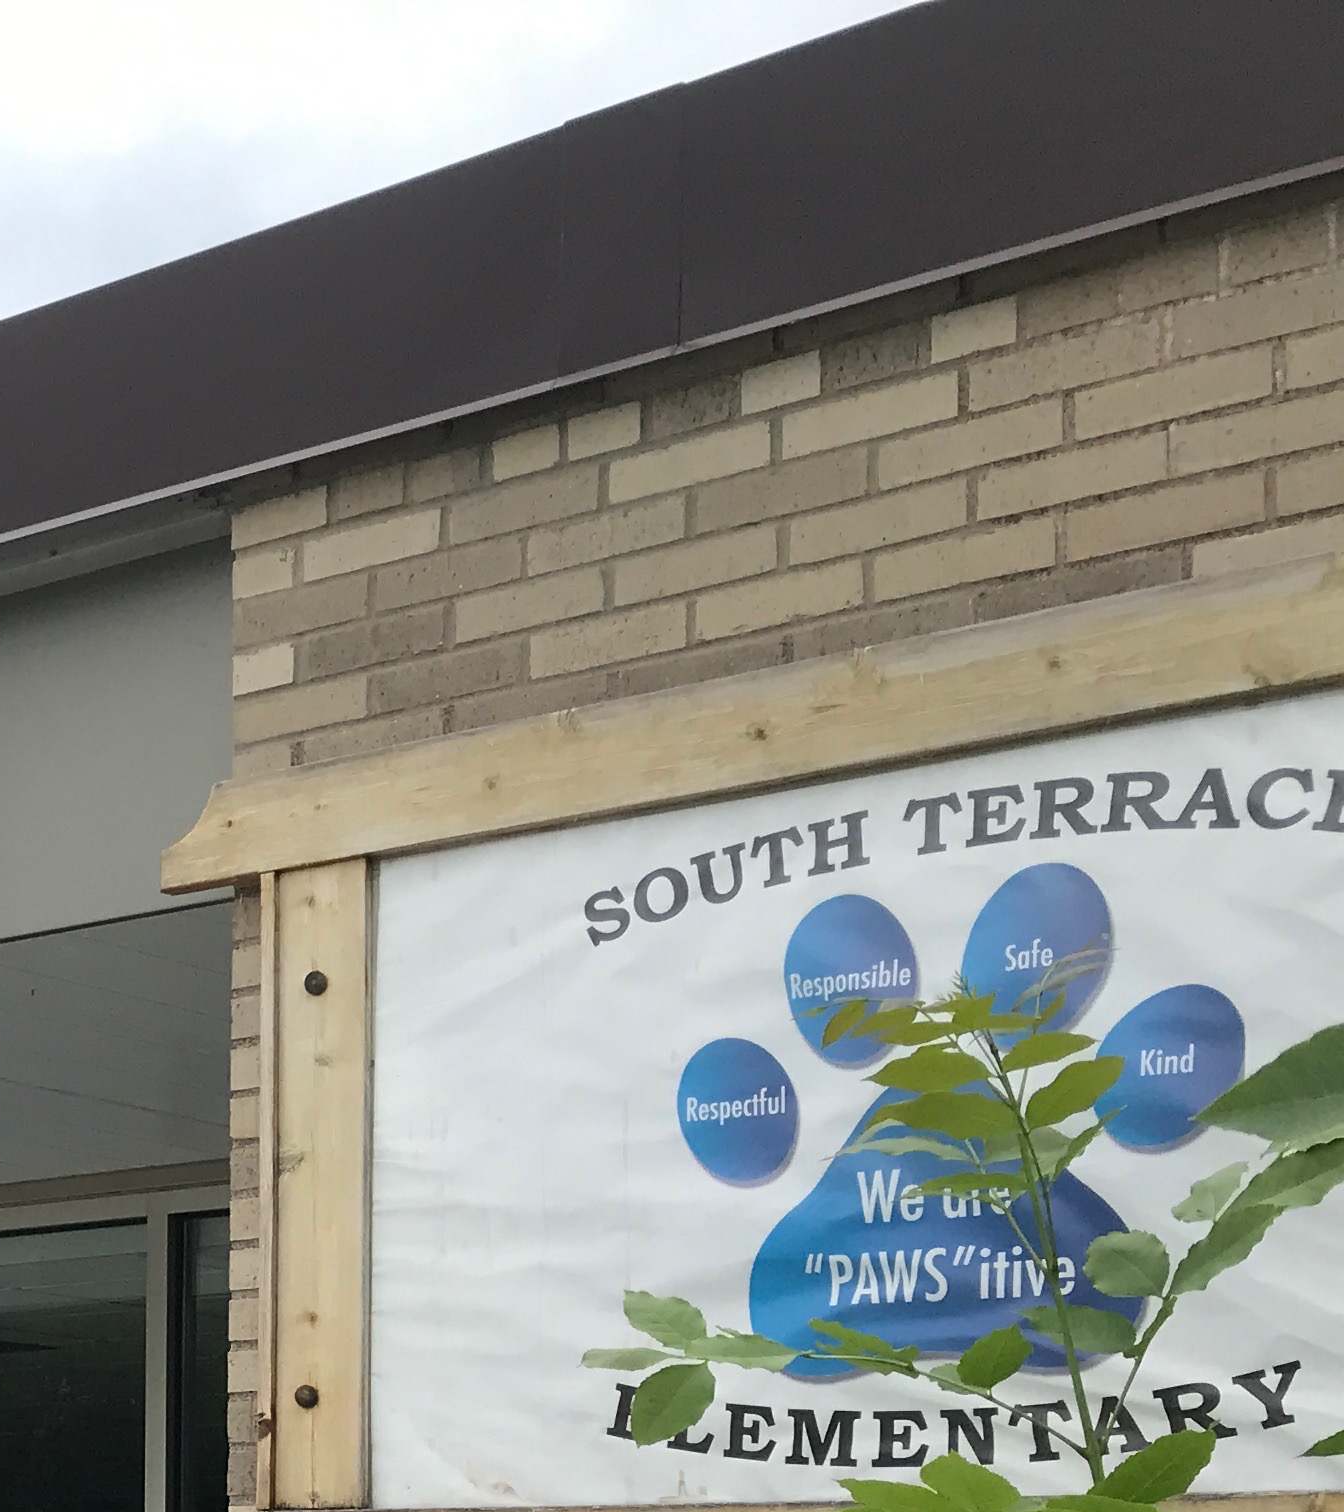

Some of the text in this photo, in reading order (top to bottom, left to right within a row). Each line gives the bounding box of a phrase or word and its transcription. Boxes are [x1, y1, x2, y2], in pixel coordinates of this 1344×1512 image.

[583, 810, 871, 947] SOUTH
[1004, 938, 1054, 972] Safe
[789, 958, 912, 1001] Responsible
[1139, 1043, 1195, 1077] Kind
[686, 1085, 786, 1126] Respectful
[857, 1168, 925, 1224] We
